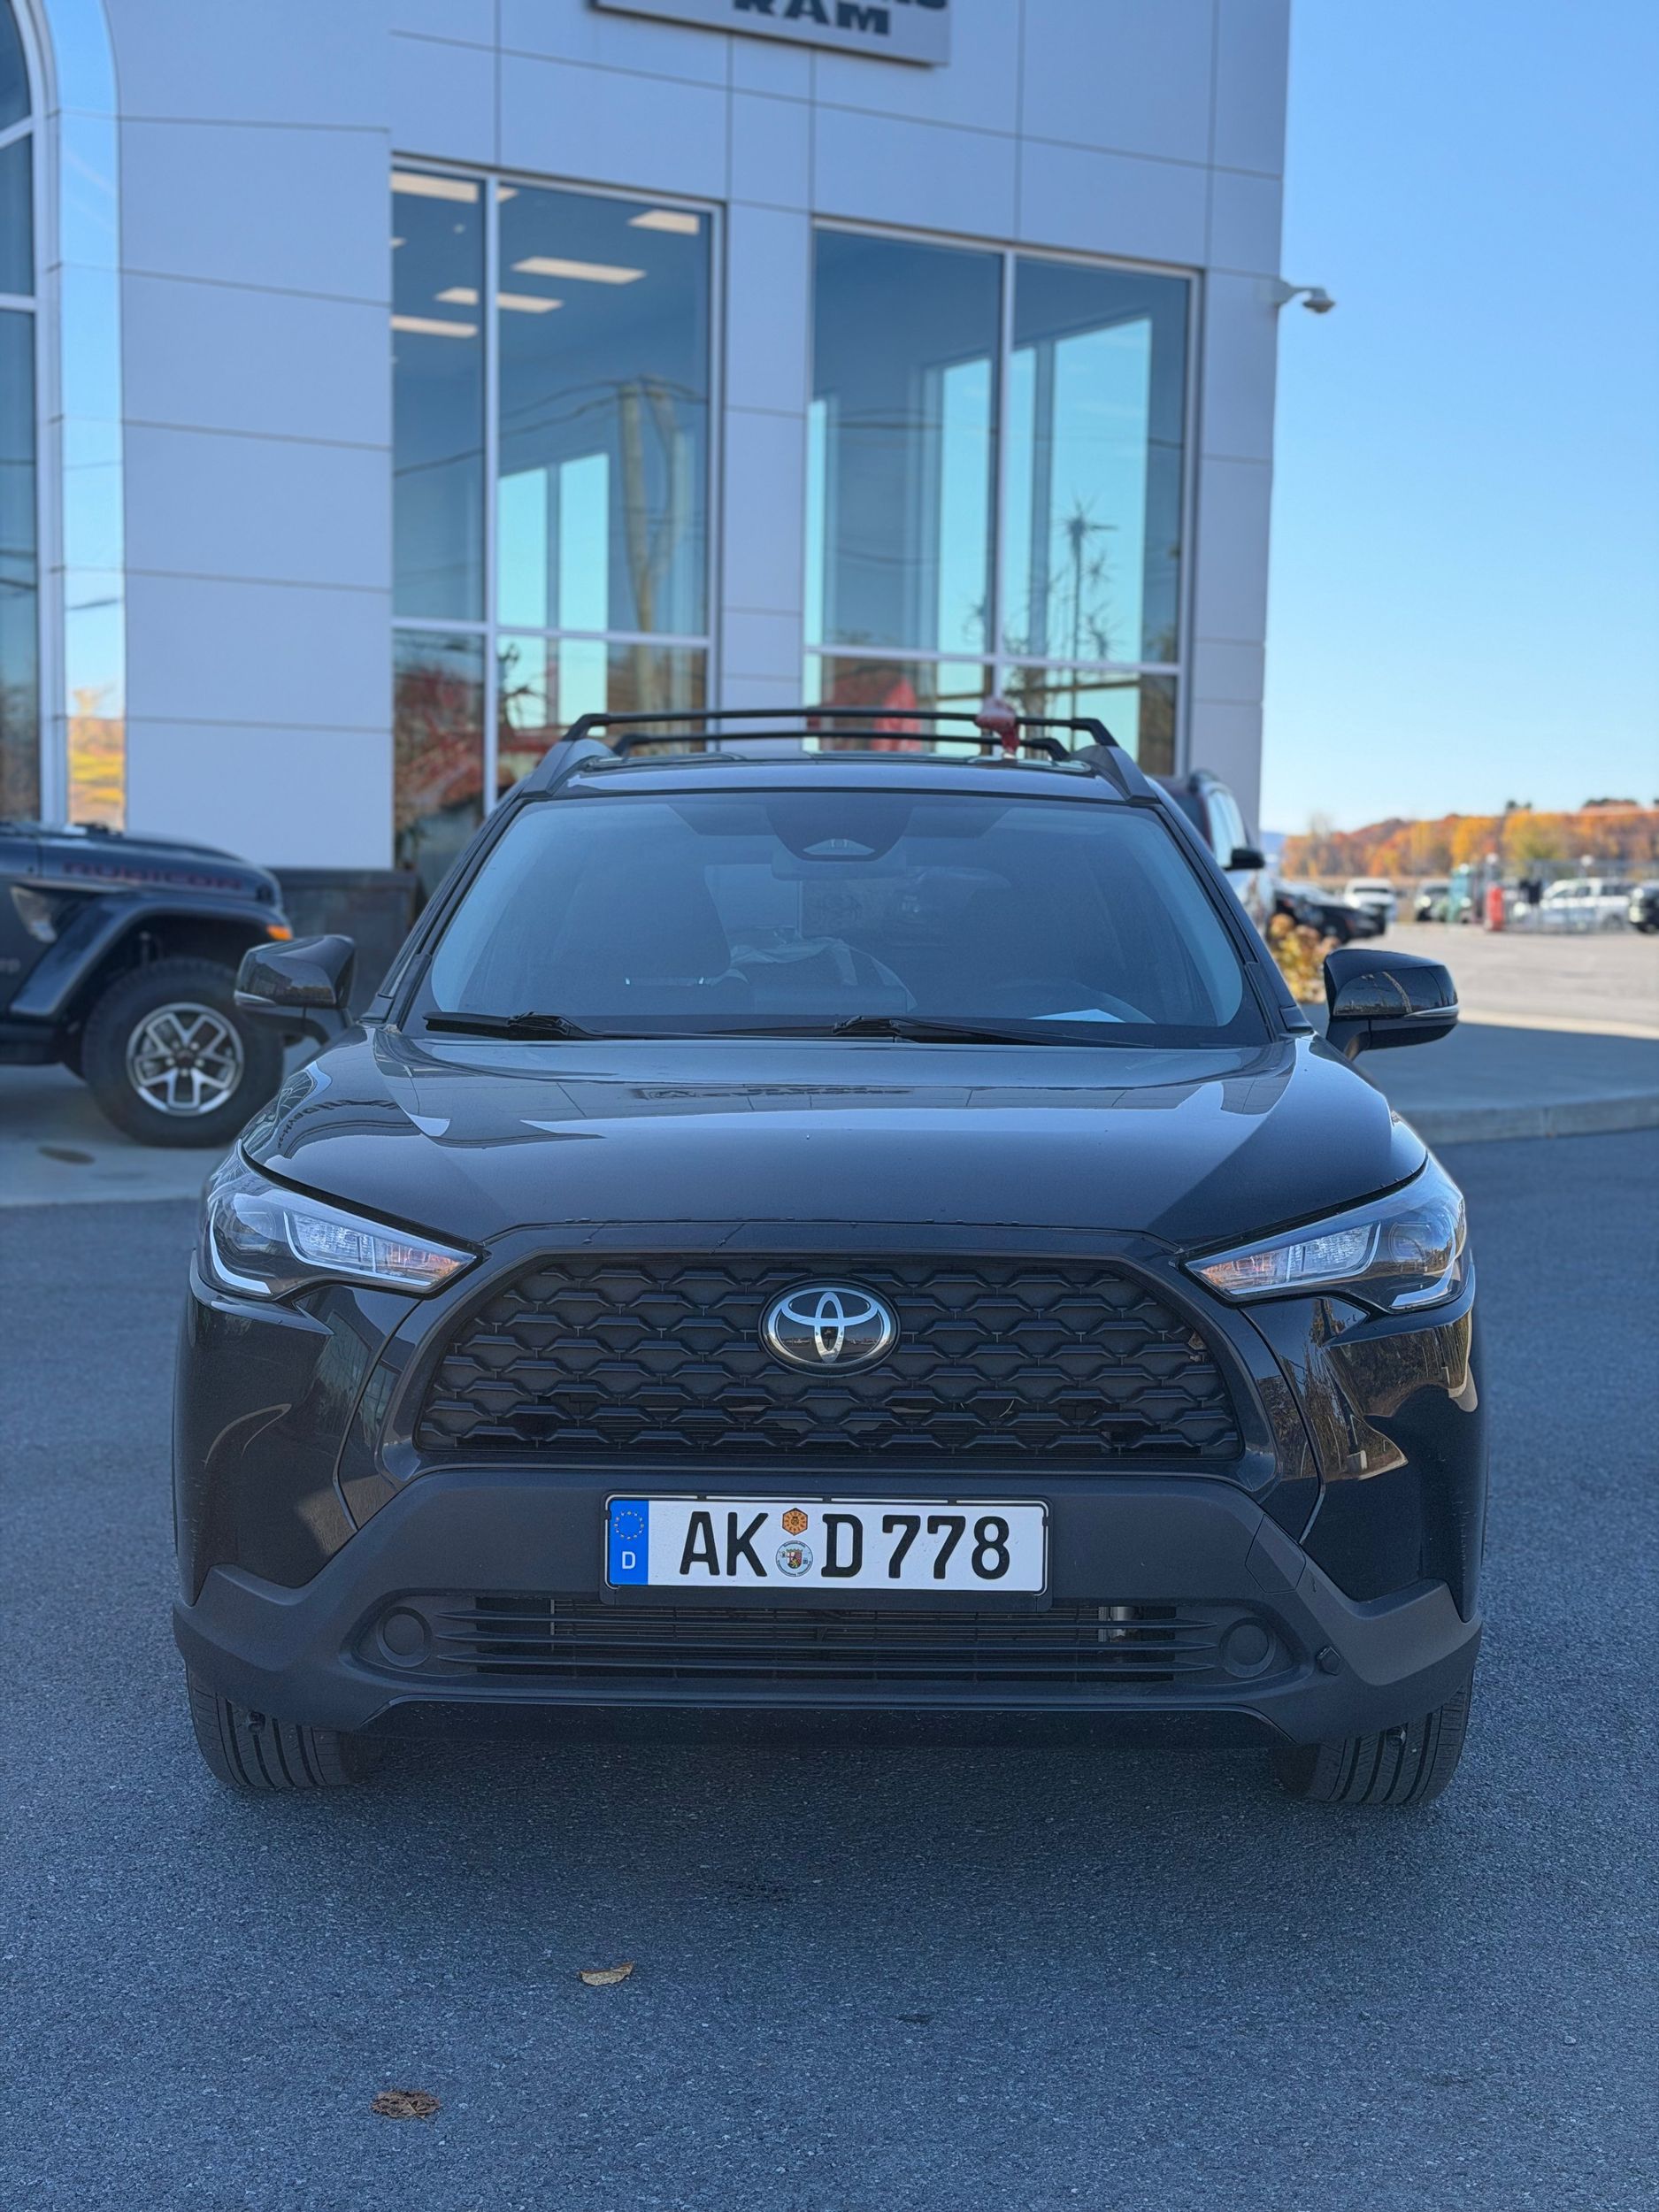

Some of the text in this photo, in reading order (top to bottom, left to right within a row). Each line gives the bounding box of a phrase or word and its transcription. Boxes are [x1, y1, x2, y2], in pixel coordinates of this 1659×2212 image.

[621, 1550, 636, 1569] D
[679, 1510, 769, 1578] AK
[820, 1513, 864, 1578] D
[882, 1514, 1010, 1580] 778
